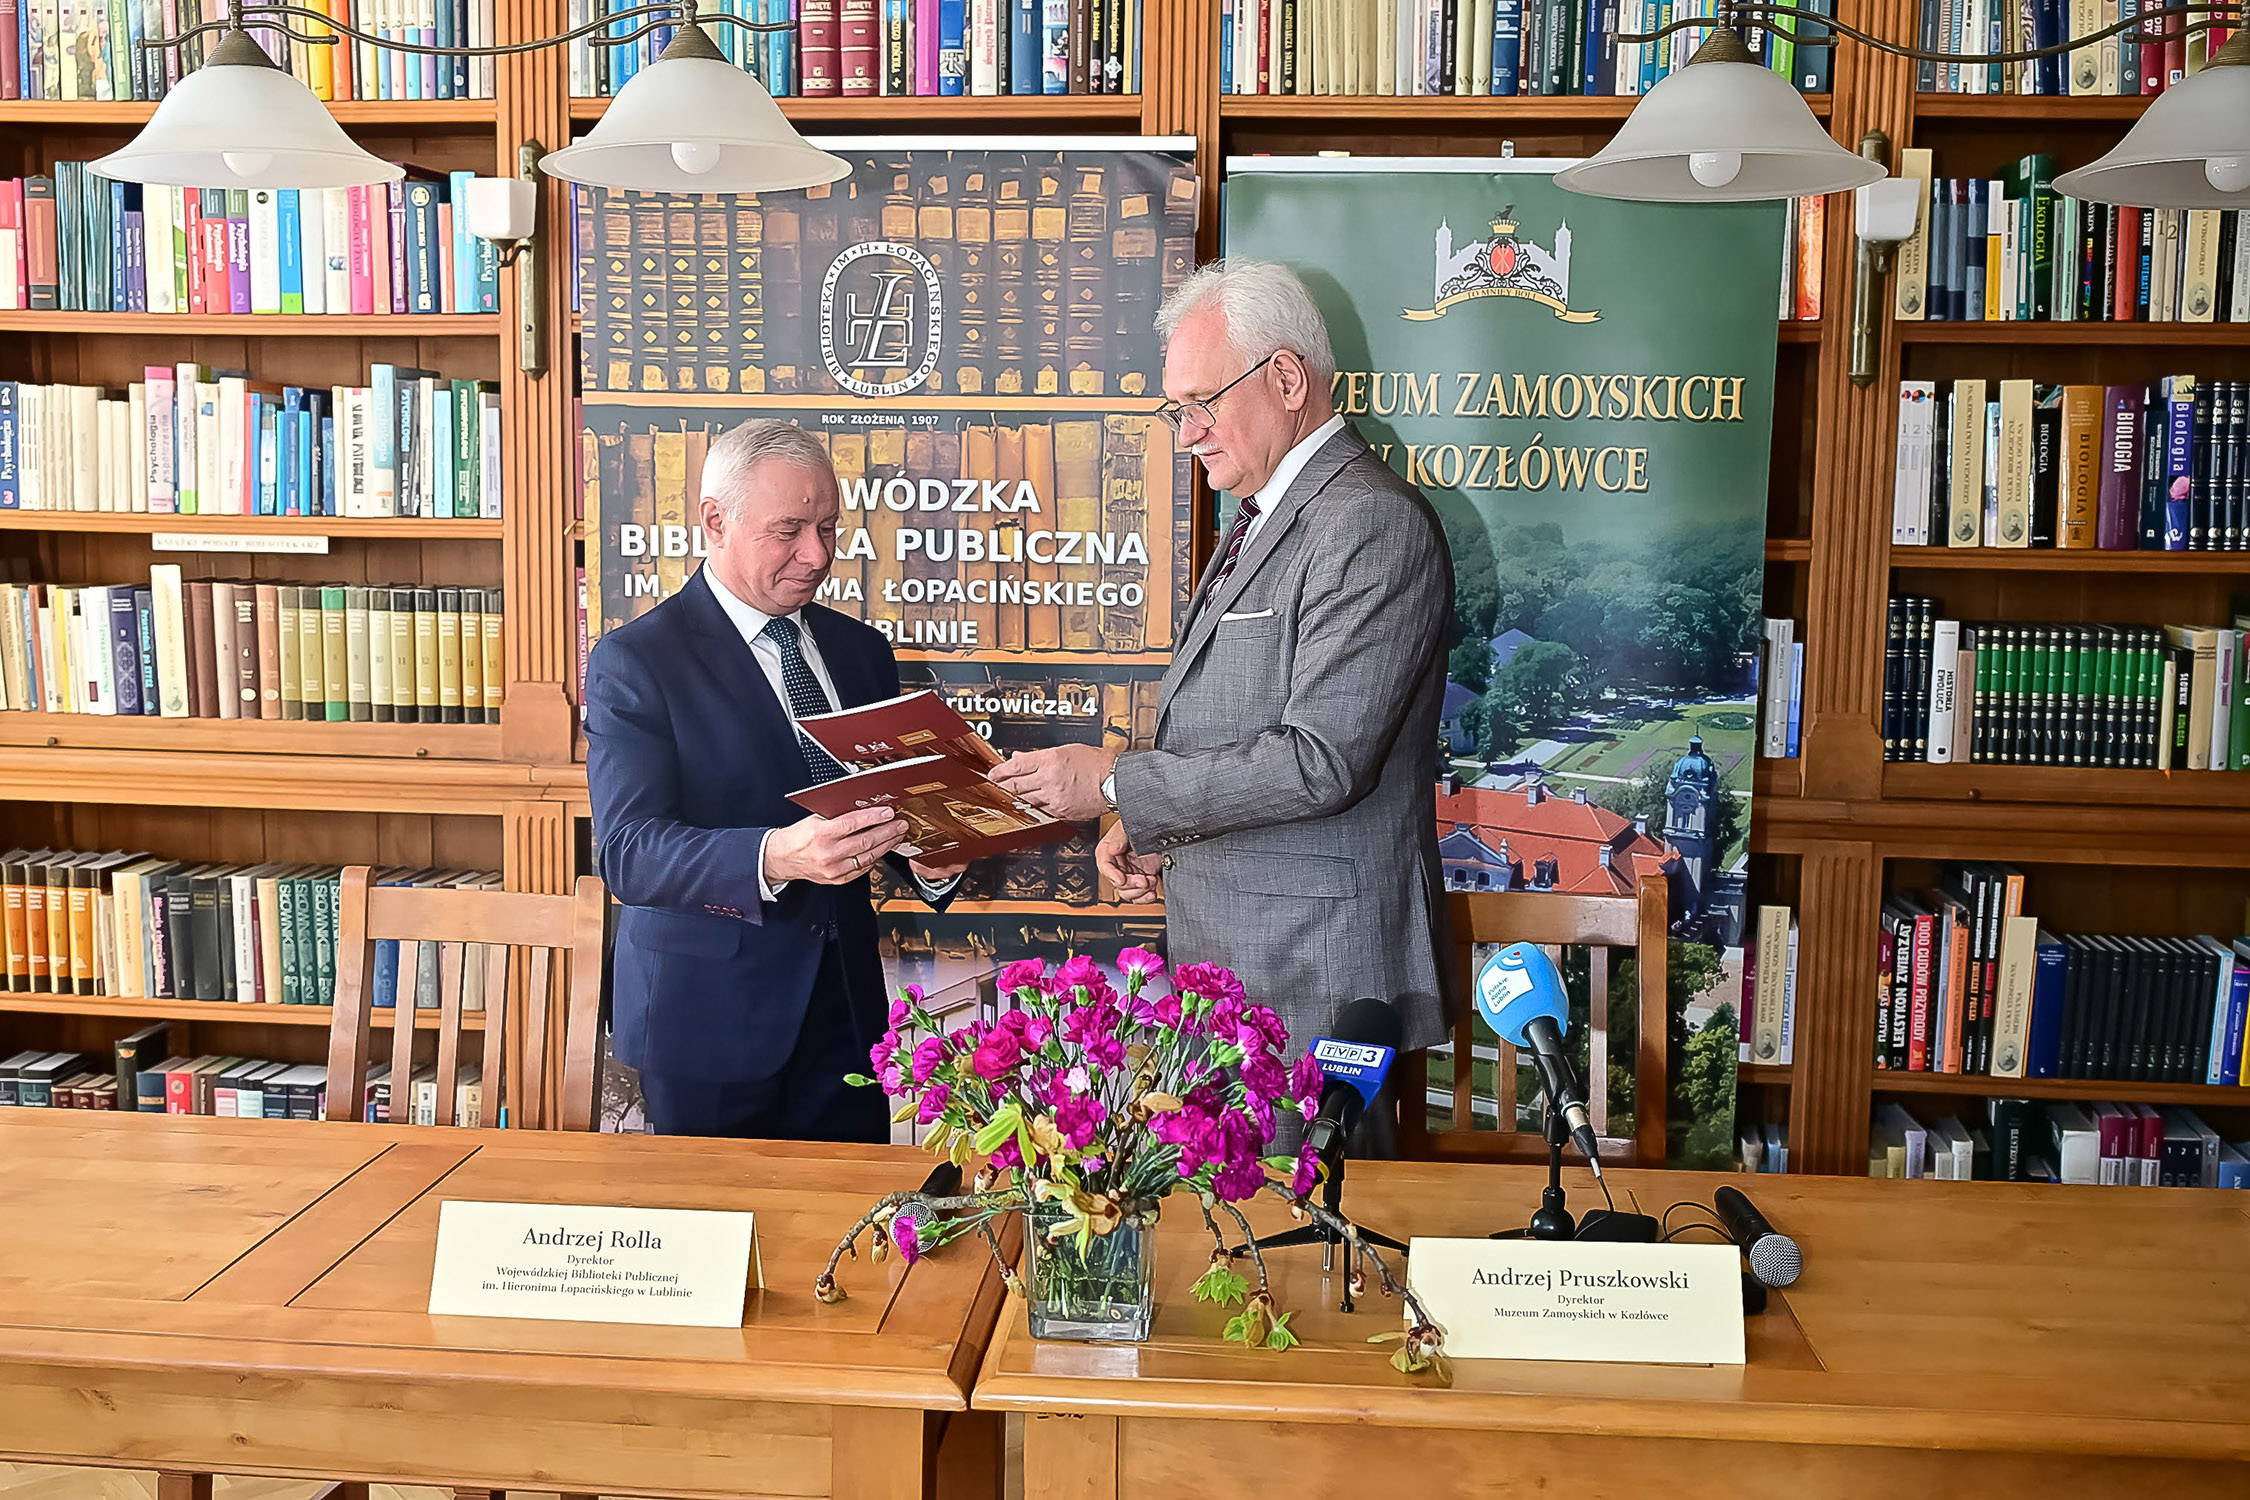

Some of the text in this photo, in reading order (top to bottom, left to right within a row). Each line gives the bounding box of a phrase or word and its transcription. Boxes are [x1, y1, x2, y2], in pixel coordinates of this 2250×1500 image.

[1284, 3, 1293, 49] GOSPODARCZA
[351, 186, 361, 241] YCHOLOGIA
[2035, 196, 2050, 261] EKOLOGIA
[2158, 220, 2165, 235] 1
[2167, 225, 2178, 239] 2
[213, 224, 224, 272] Psychologia
[236, 222, 248, 272] Psychologia
[480, 238, 498, 282] Psychol
[833, 253, 850, 271] IM
[2140, 212, 2153, 305] SŁOWNIK MATEMATYKA
[236, 292, 246, 305] 2
[821, 280, 842, 377] BIBLIOTEKA
[851, 380, 910, 396] LUBLIN
[1330, 371, 1746, 421] ZEUM ZAMOYSKICH
[821, 412, 940, 426] ROK ZŁOŻENIA 1907
[1913, 424, 1921, 435] 2
[2171, 402, 2190, 472] Biologia
[0, 420, 16, 481] Psychologia
[149, 414, 159, 483] Psychologia
[1407, 432, 1650, 492] KOZŁÓWCE
[2038, 423, 2050, 474] BIOLOGIA
[2113, 412, 2135, 473] BIOLOGIA
[842, 471, 1041, 513] WÓDZKA
[2075, 433, 2091, 514] BIOLOGIA
[619, 523, 1150, 565] BIBLKA PUBLICZNA
[624, 573, 670, 598] IM.
[881, 575, 1145, 608] ŁOPACIŃSKIEGO
[868, 619, 979, 646] BLINIE
[466, 659, 475, 668] 14
[947, 694, 1099, 717] rutowicza 4
[1935, 668, 1945, 713] EWOLUCJI
[1945, 671, 1954, 712] HISTORIA
[2177, 673, 2189, 747] SŁOWNIK BIOLOGIA
[1772, 911, 1782, 967] SZKOLNICTWO
[1494, 990, 1511, 1007] Lublin
[1893, 923, 1913, 1048] LEKSYKON ZWIERZĄT
[1913, 921, 1930, 1043] 1000 CUDÓW PRZYRODY
[1878, 986, 1889, 1042] ATLAS MOTYLI
[1969, 996, 1979, 1021] POLSKI
[1322, 1044, 1377, 1063] TVP 3
[1322, 1063, 1362, 1077] LUBLIN
[522, 1227, 663, 1252] Andrzej Rolla
[567, 1254, 615, 1267] Dyrektor
[482, 1281, 499, 1291] im.
[502, 1281, 558, 1294] Hieronima
[637, 1289, 647, 1297] w
[649, 1286, 693, 1299] Lublinie
[496, 1266, 679, 1285] Wojewódzkiej Biblioteki Publicznej
[1471, 1268, 1690, 1292] Andrzej Pruszkowski
[1494, 1307, 1539, 1319] Muzeum
[1542, 1308, 1606, 1322] Zamoyskich
[1608, 1312, 1618, 1320] w
[1557, 1294, 1605, 1308] Dyrektor
